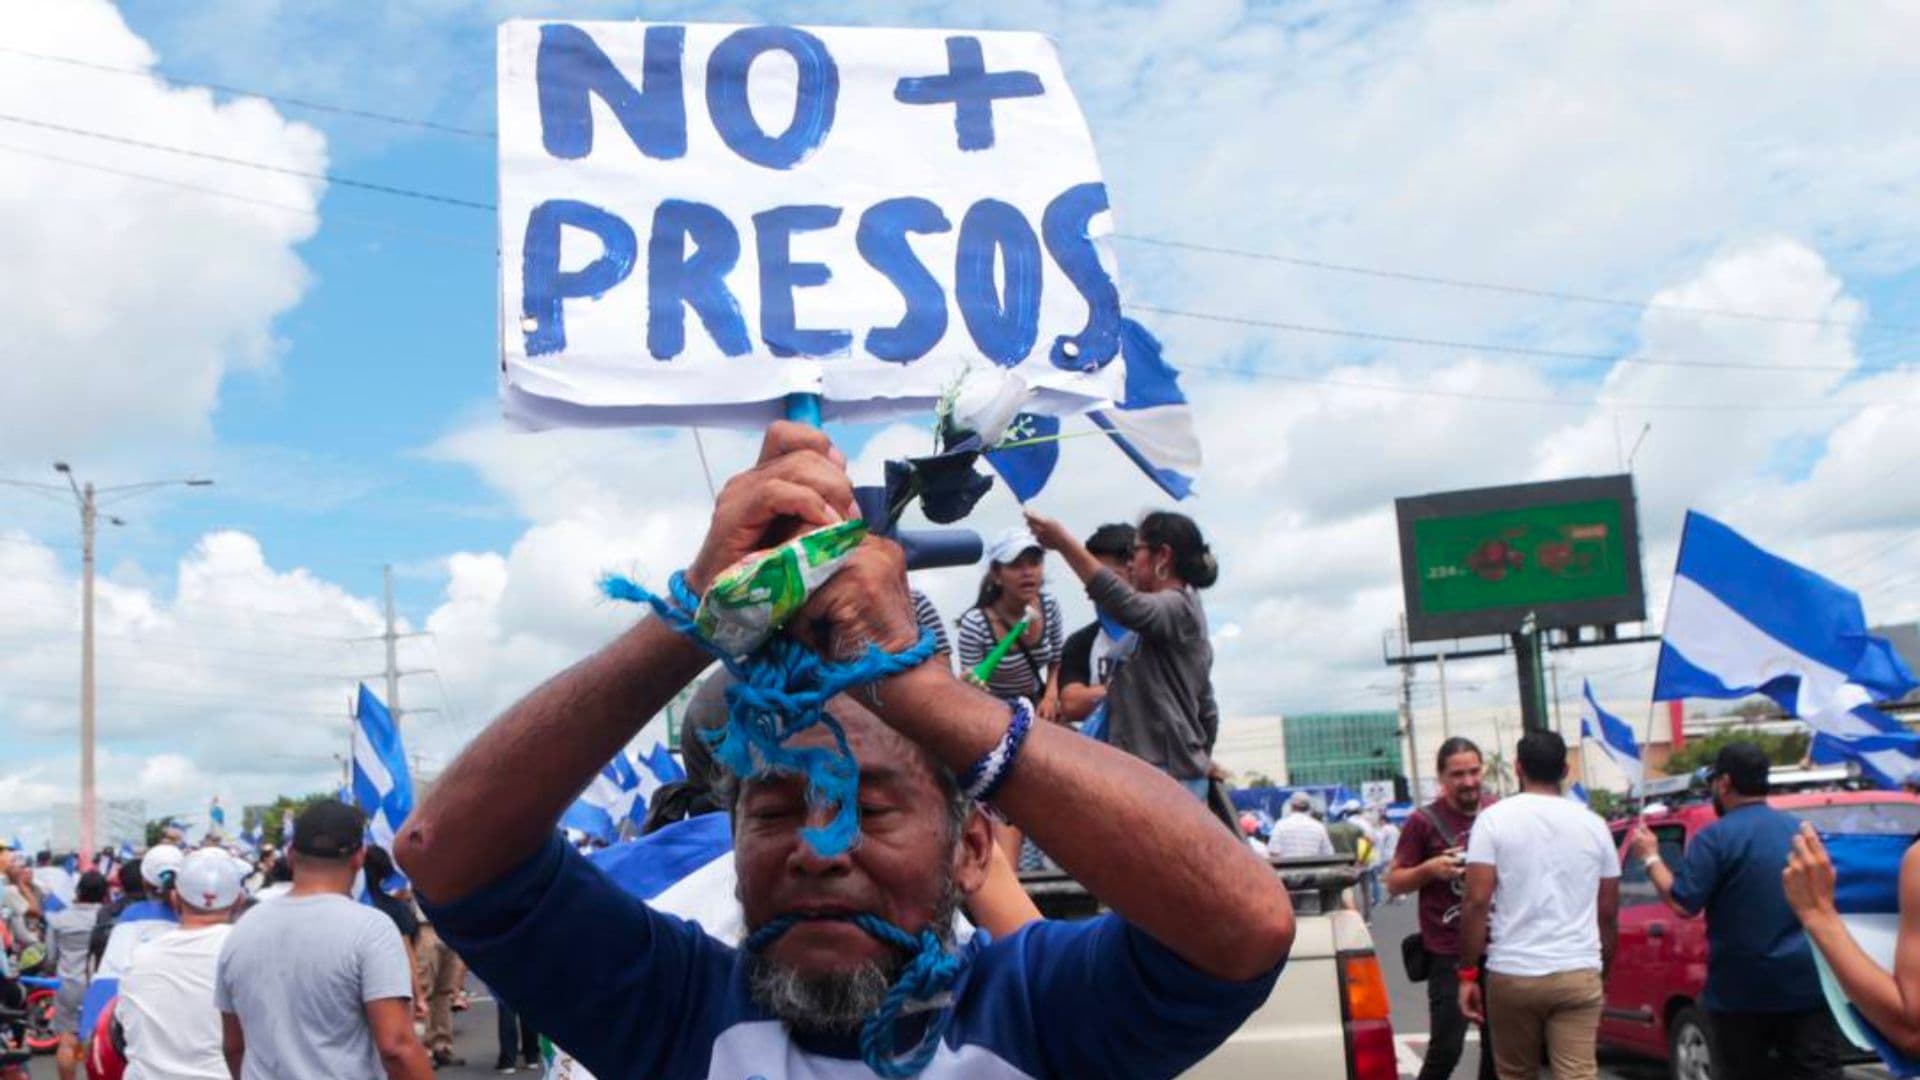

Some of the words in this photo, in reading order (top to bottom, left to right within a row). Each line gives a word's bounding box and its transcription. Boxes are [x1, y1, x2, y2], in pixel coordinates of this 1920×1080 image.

[537, 24, 839, 170] NO
[894, 37, 1044, 151] +
[522, 182, 1121, 371] PRESOS
